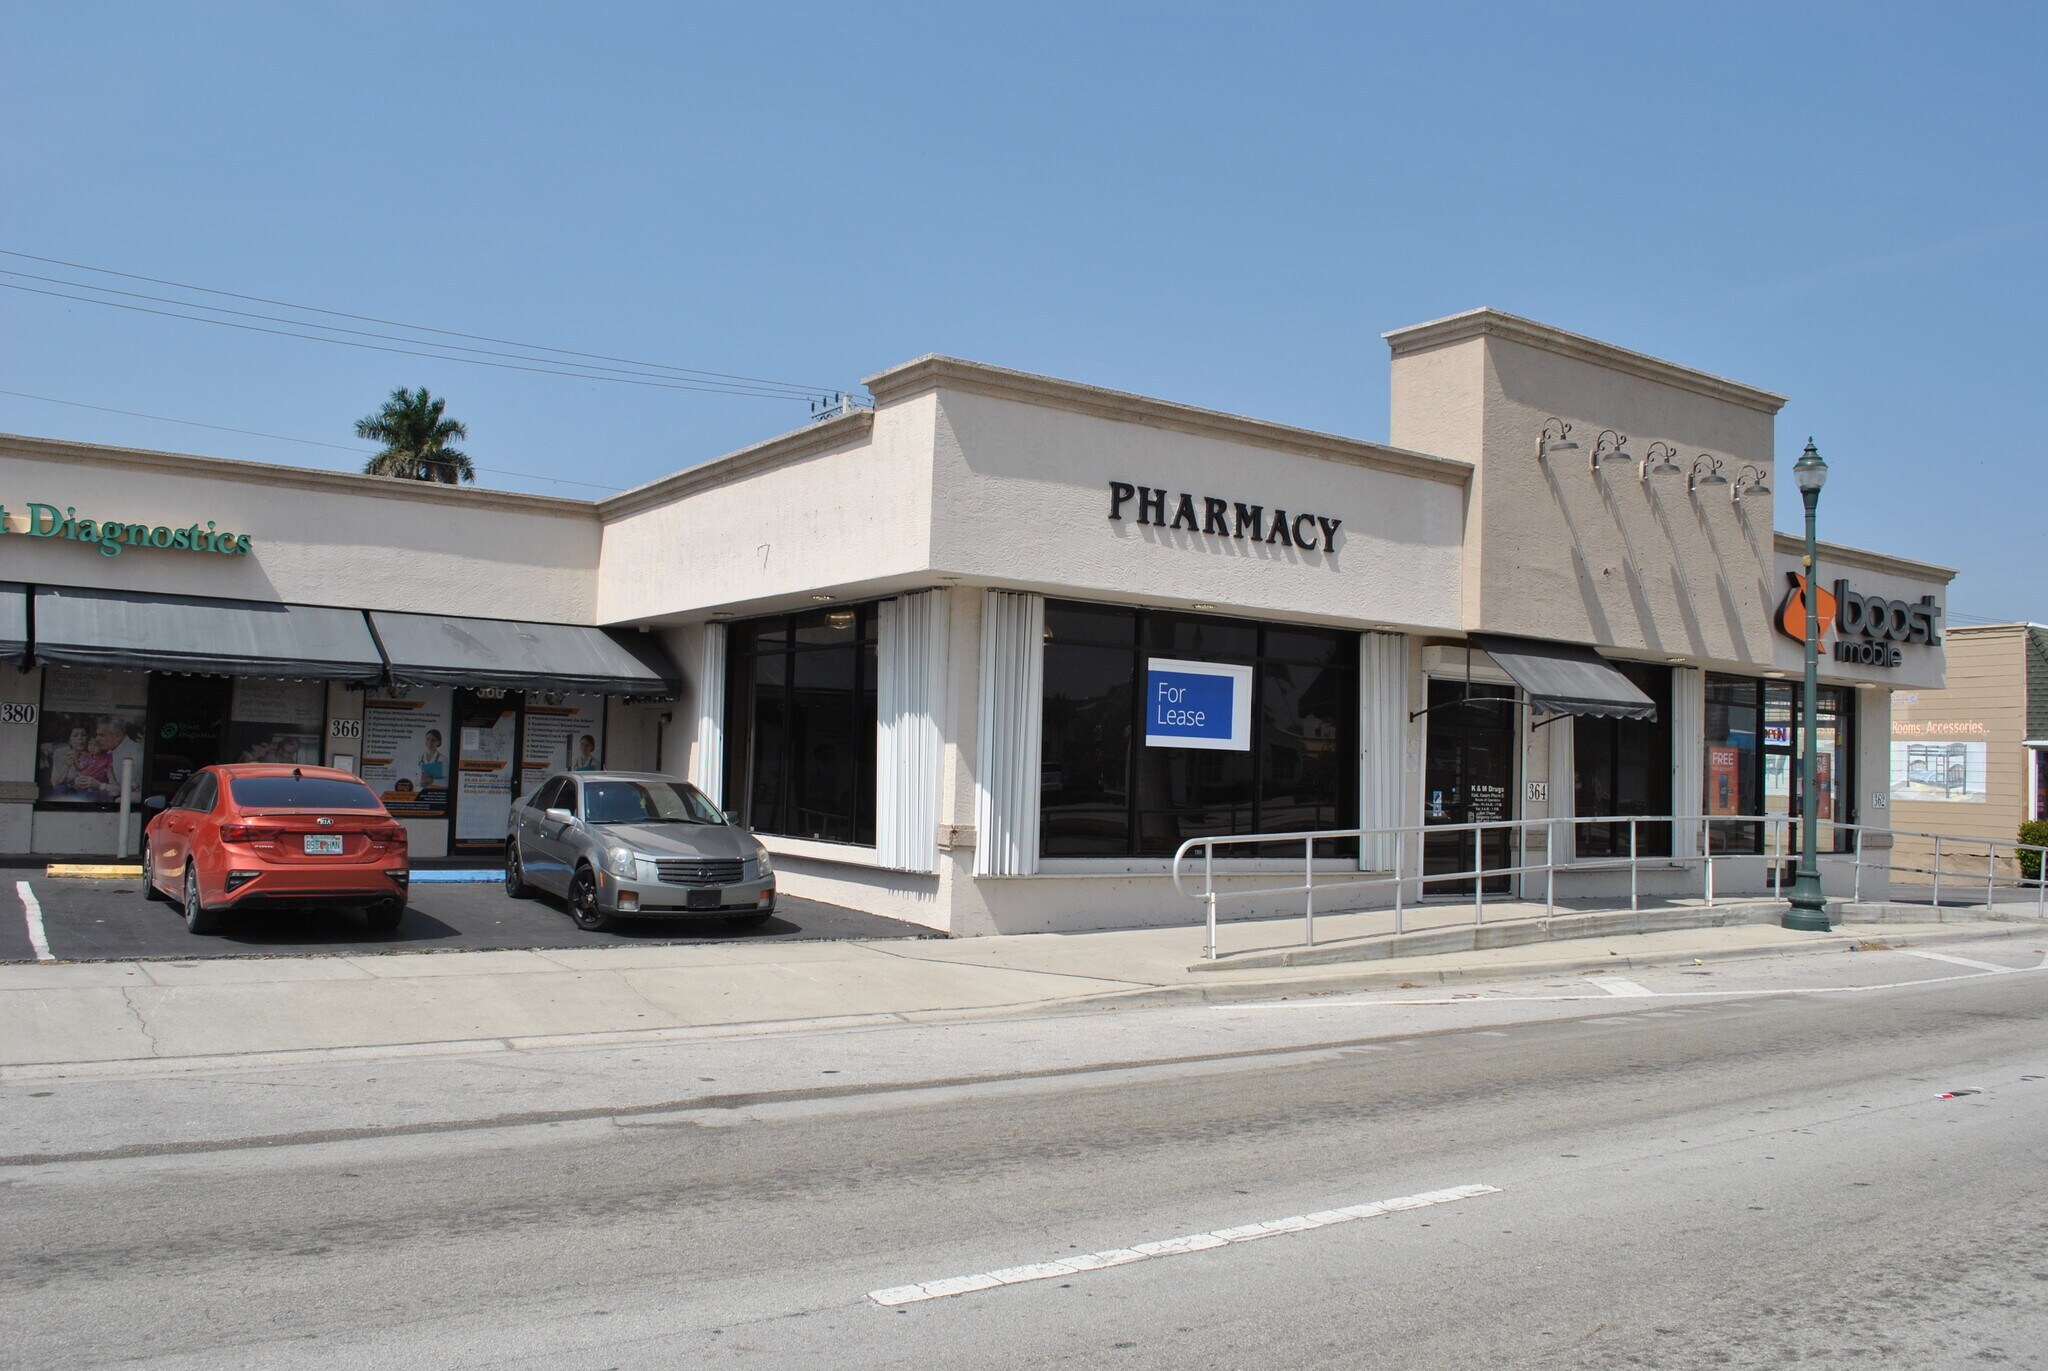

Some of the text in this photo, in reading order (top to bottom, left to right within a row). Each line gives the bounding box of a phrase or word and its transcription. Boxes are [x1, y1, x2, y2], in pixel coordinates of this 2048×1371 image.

[1108, 481, 1342, 553] PHARMACY
[26, 502, 253, 558] Diagnostics
[1834, 578, 1942, 646] boost
[1834, 640, 1902, 667] mobile
[1158, 682, 1186, 703] For
[2, 703, 35, 723] 380
[1157, 705, 1205, 727] Lease
[331, 720, 359, 738] 366
[1712, 752, 1734, 766] FREE
[1488, 785, 1504, 794] Drugs
[1528, 783, 1546, 800] 364
